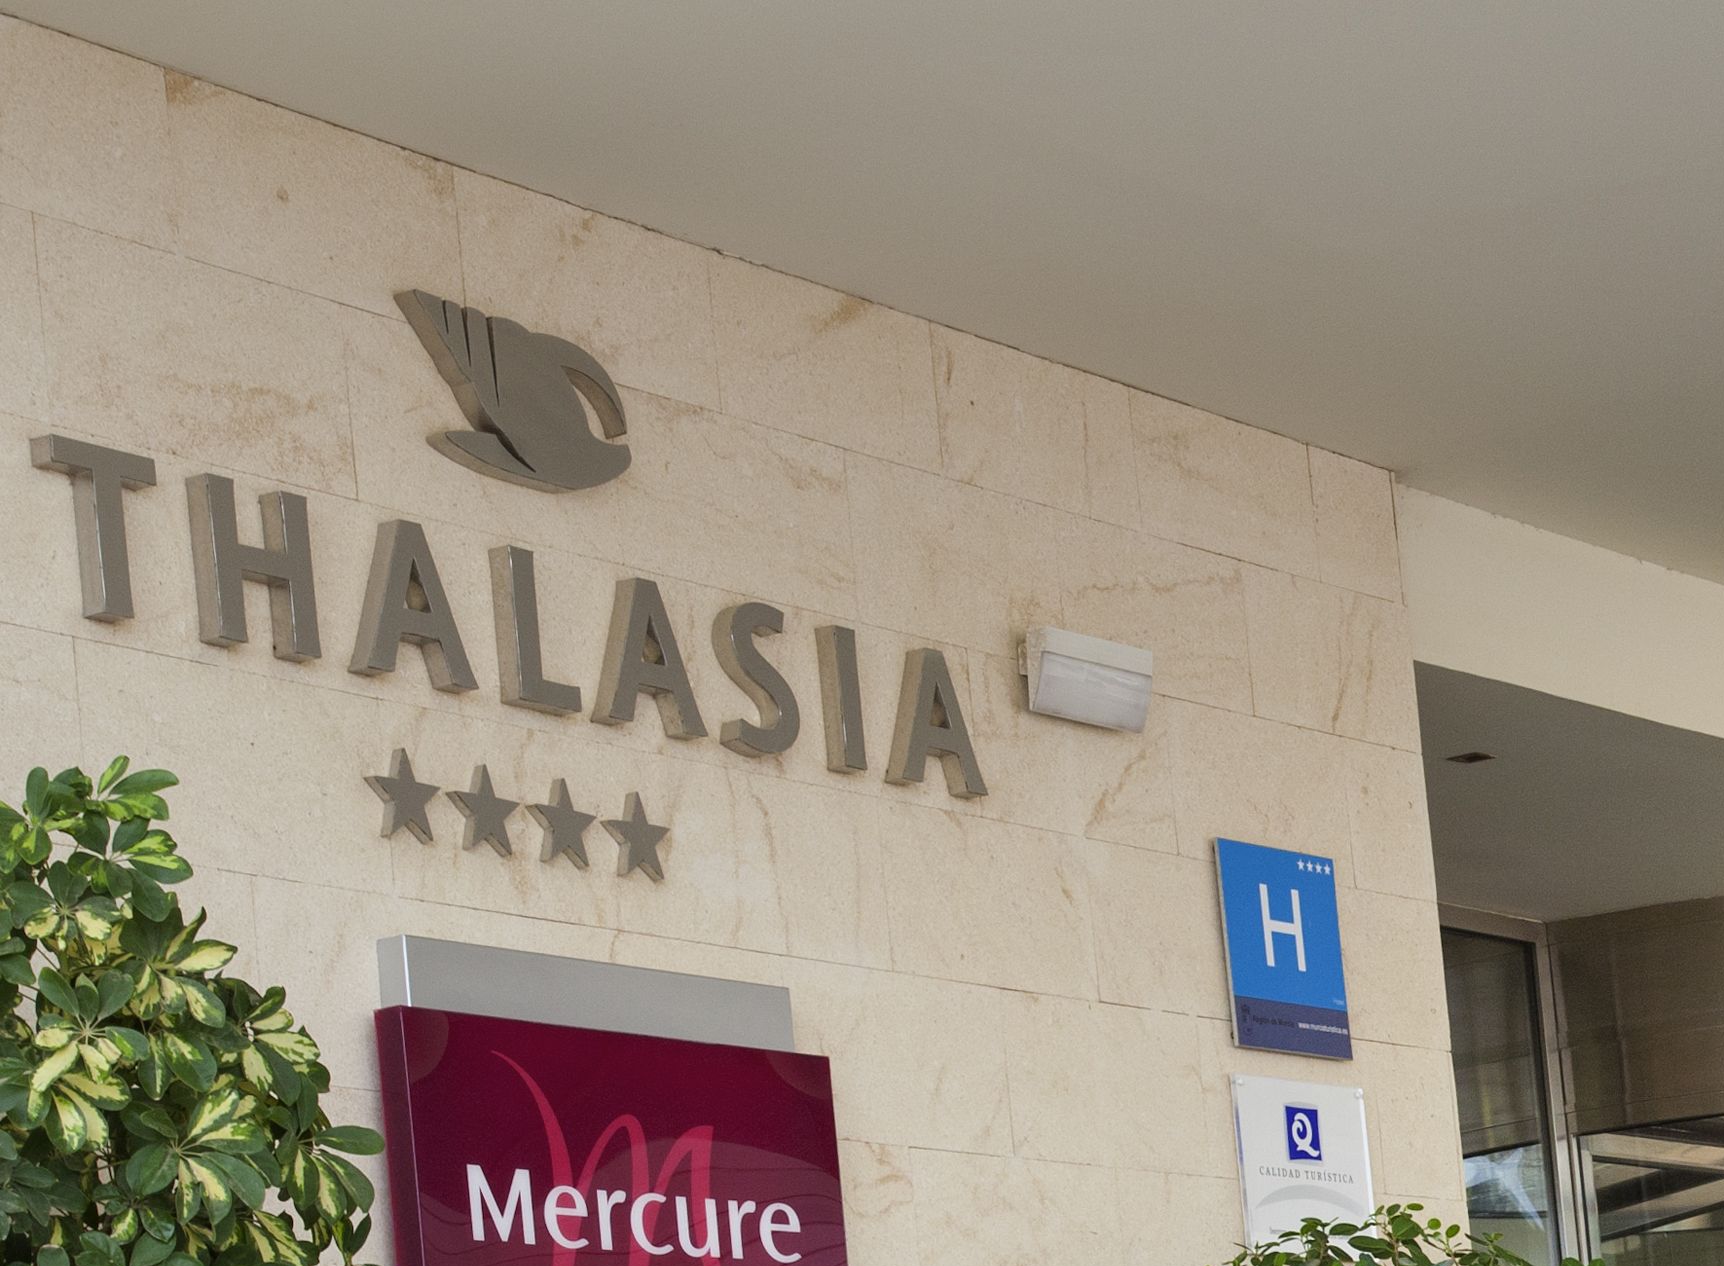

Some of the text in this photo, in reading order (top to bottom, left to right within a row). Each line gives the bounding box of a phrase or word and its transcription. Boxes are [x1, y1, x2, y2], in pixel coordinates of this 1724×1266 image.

[28, 434, 988, 799] THALASIA
[1259, 883, 1307, 972] H
[1259, 1165, 1354, 1184] CALIDAD TURÍSTICA
[1291, 1112, 1320, 1159] Q
[466, 1163, 802, 1264] Mercure
